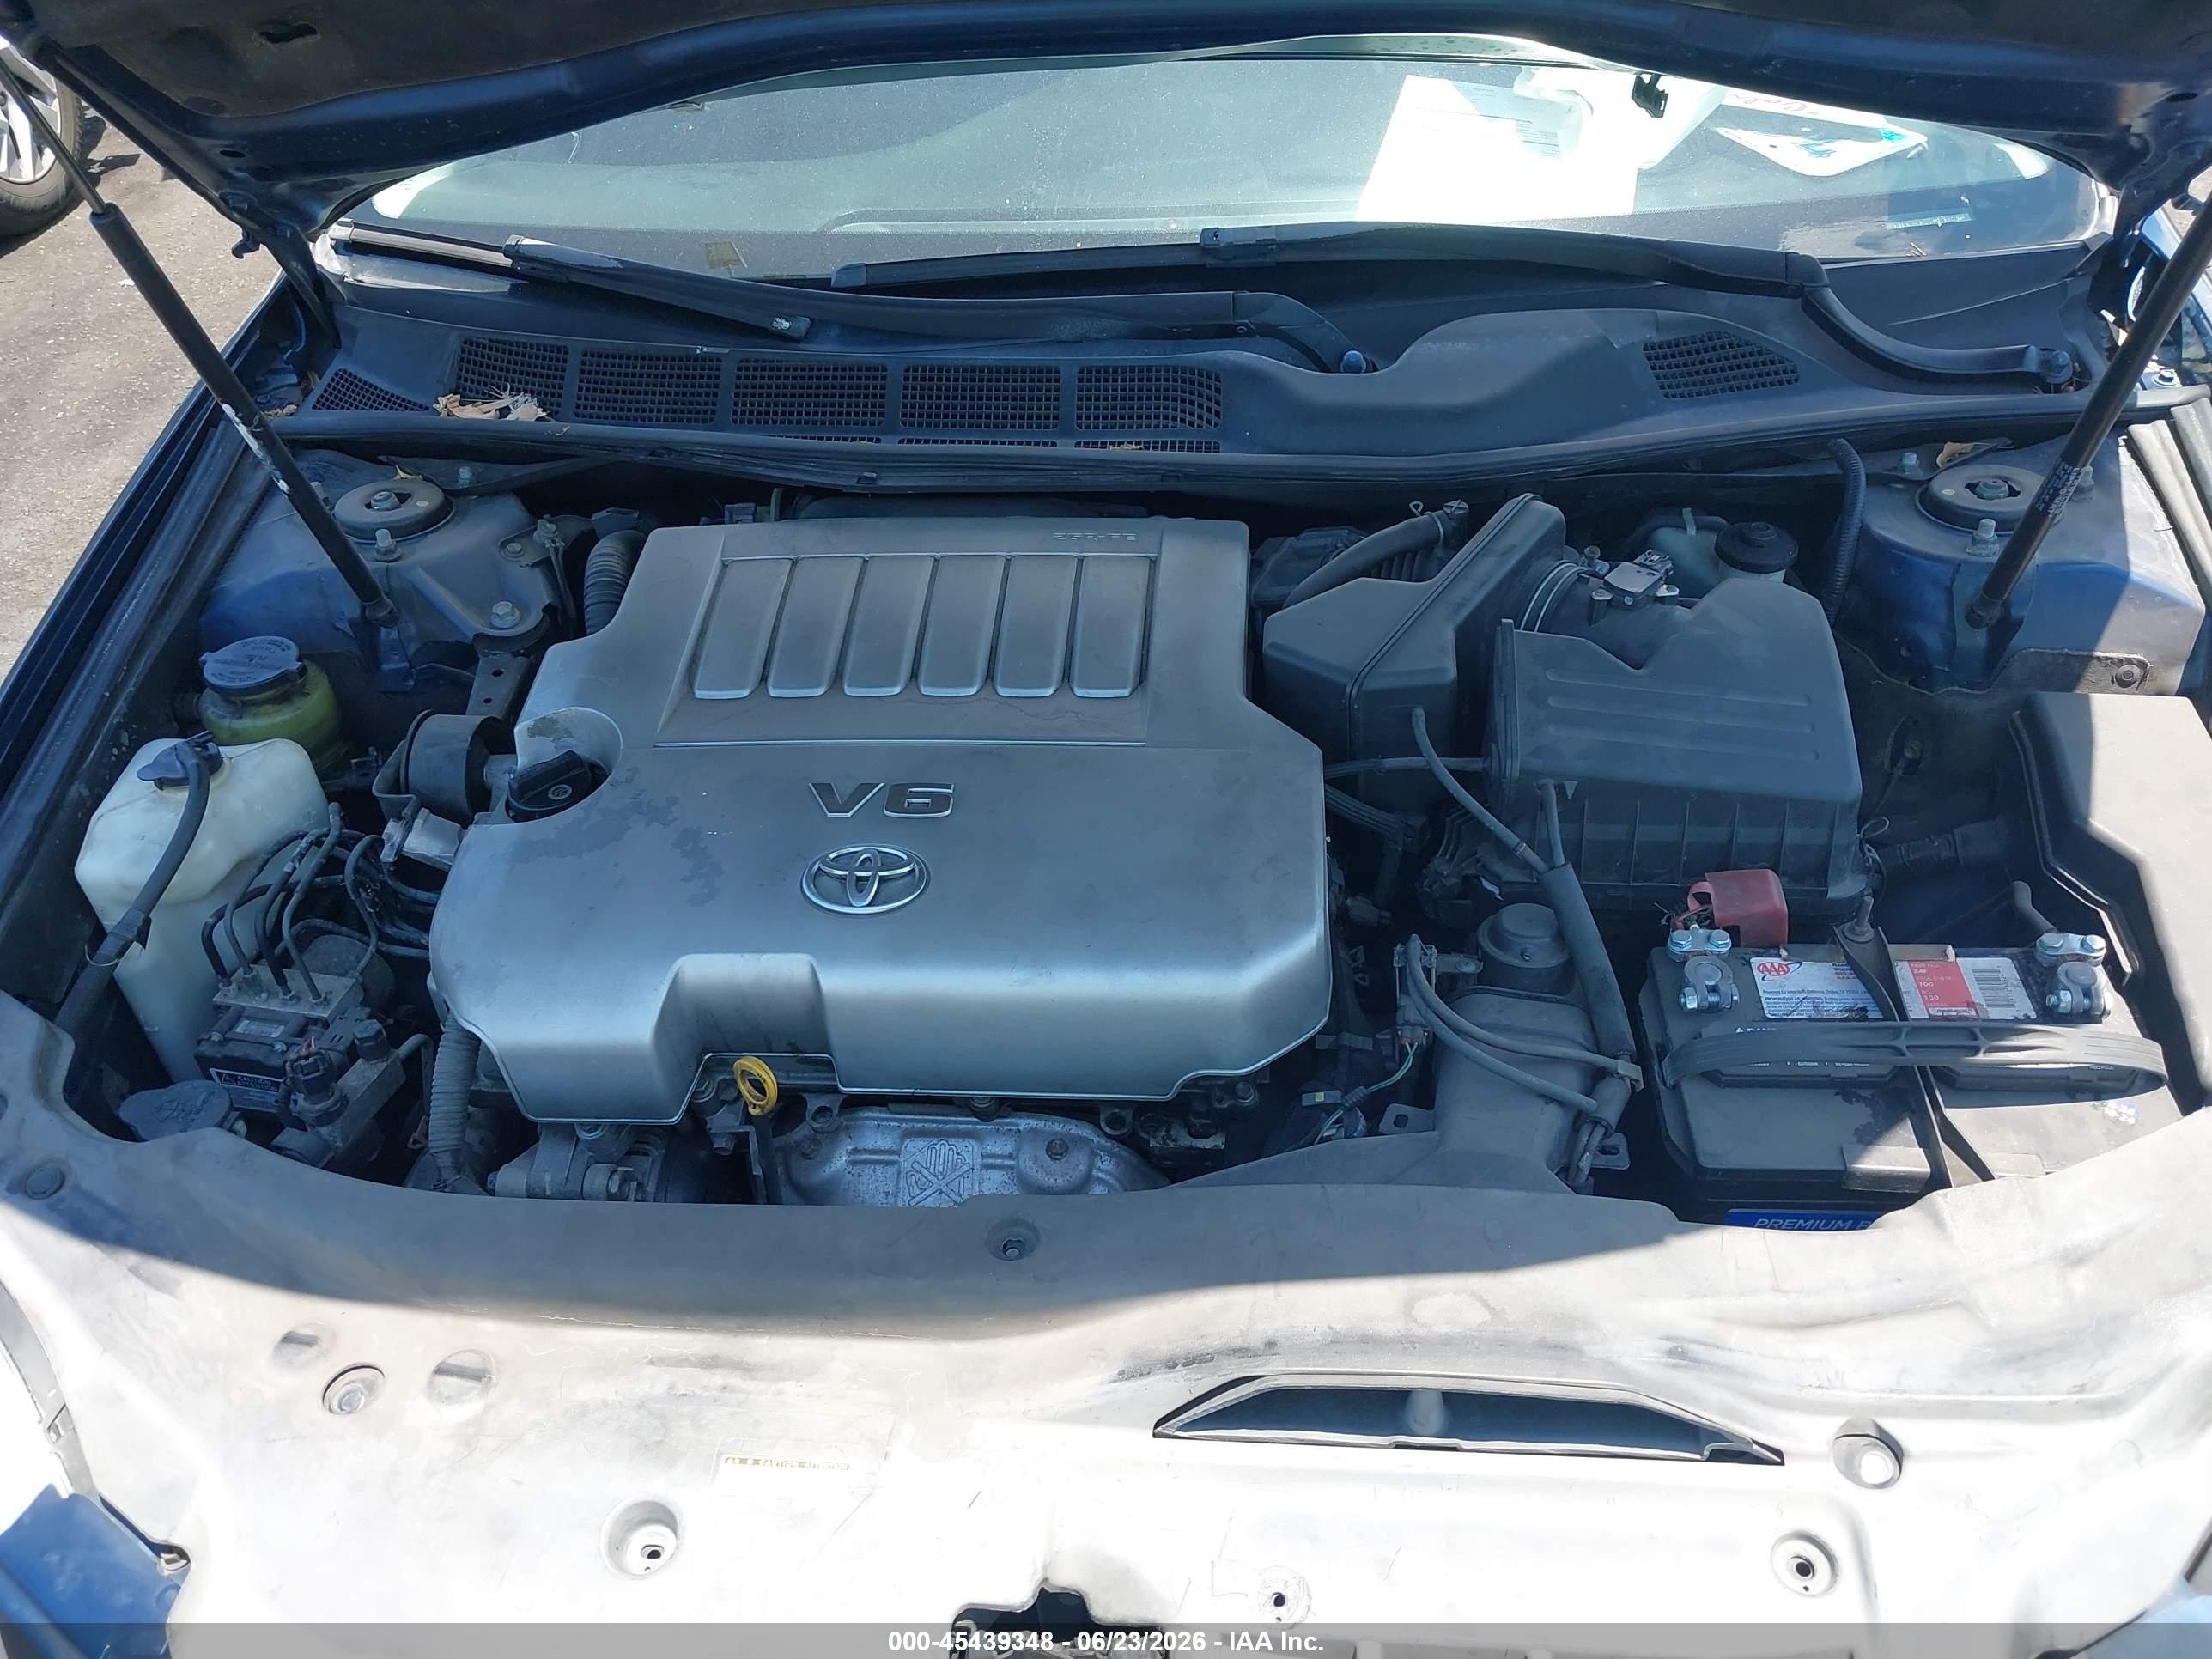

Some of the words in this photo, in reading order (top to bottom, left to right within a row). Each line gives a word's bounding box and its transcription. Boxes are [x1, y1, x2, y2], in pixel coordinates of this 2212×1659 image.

[808, 782, 955, 818] V6
[1759, 962, 1788, 975] AAA
[1754, 1218, 1852, 1230] PREMIUM
